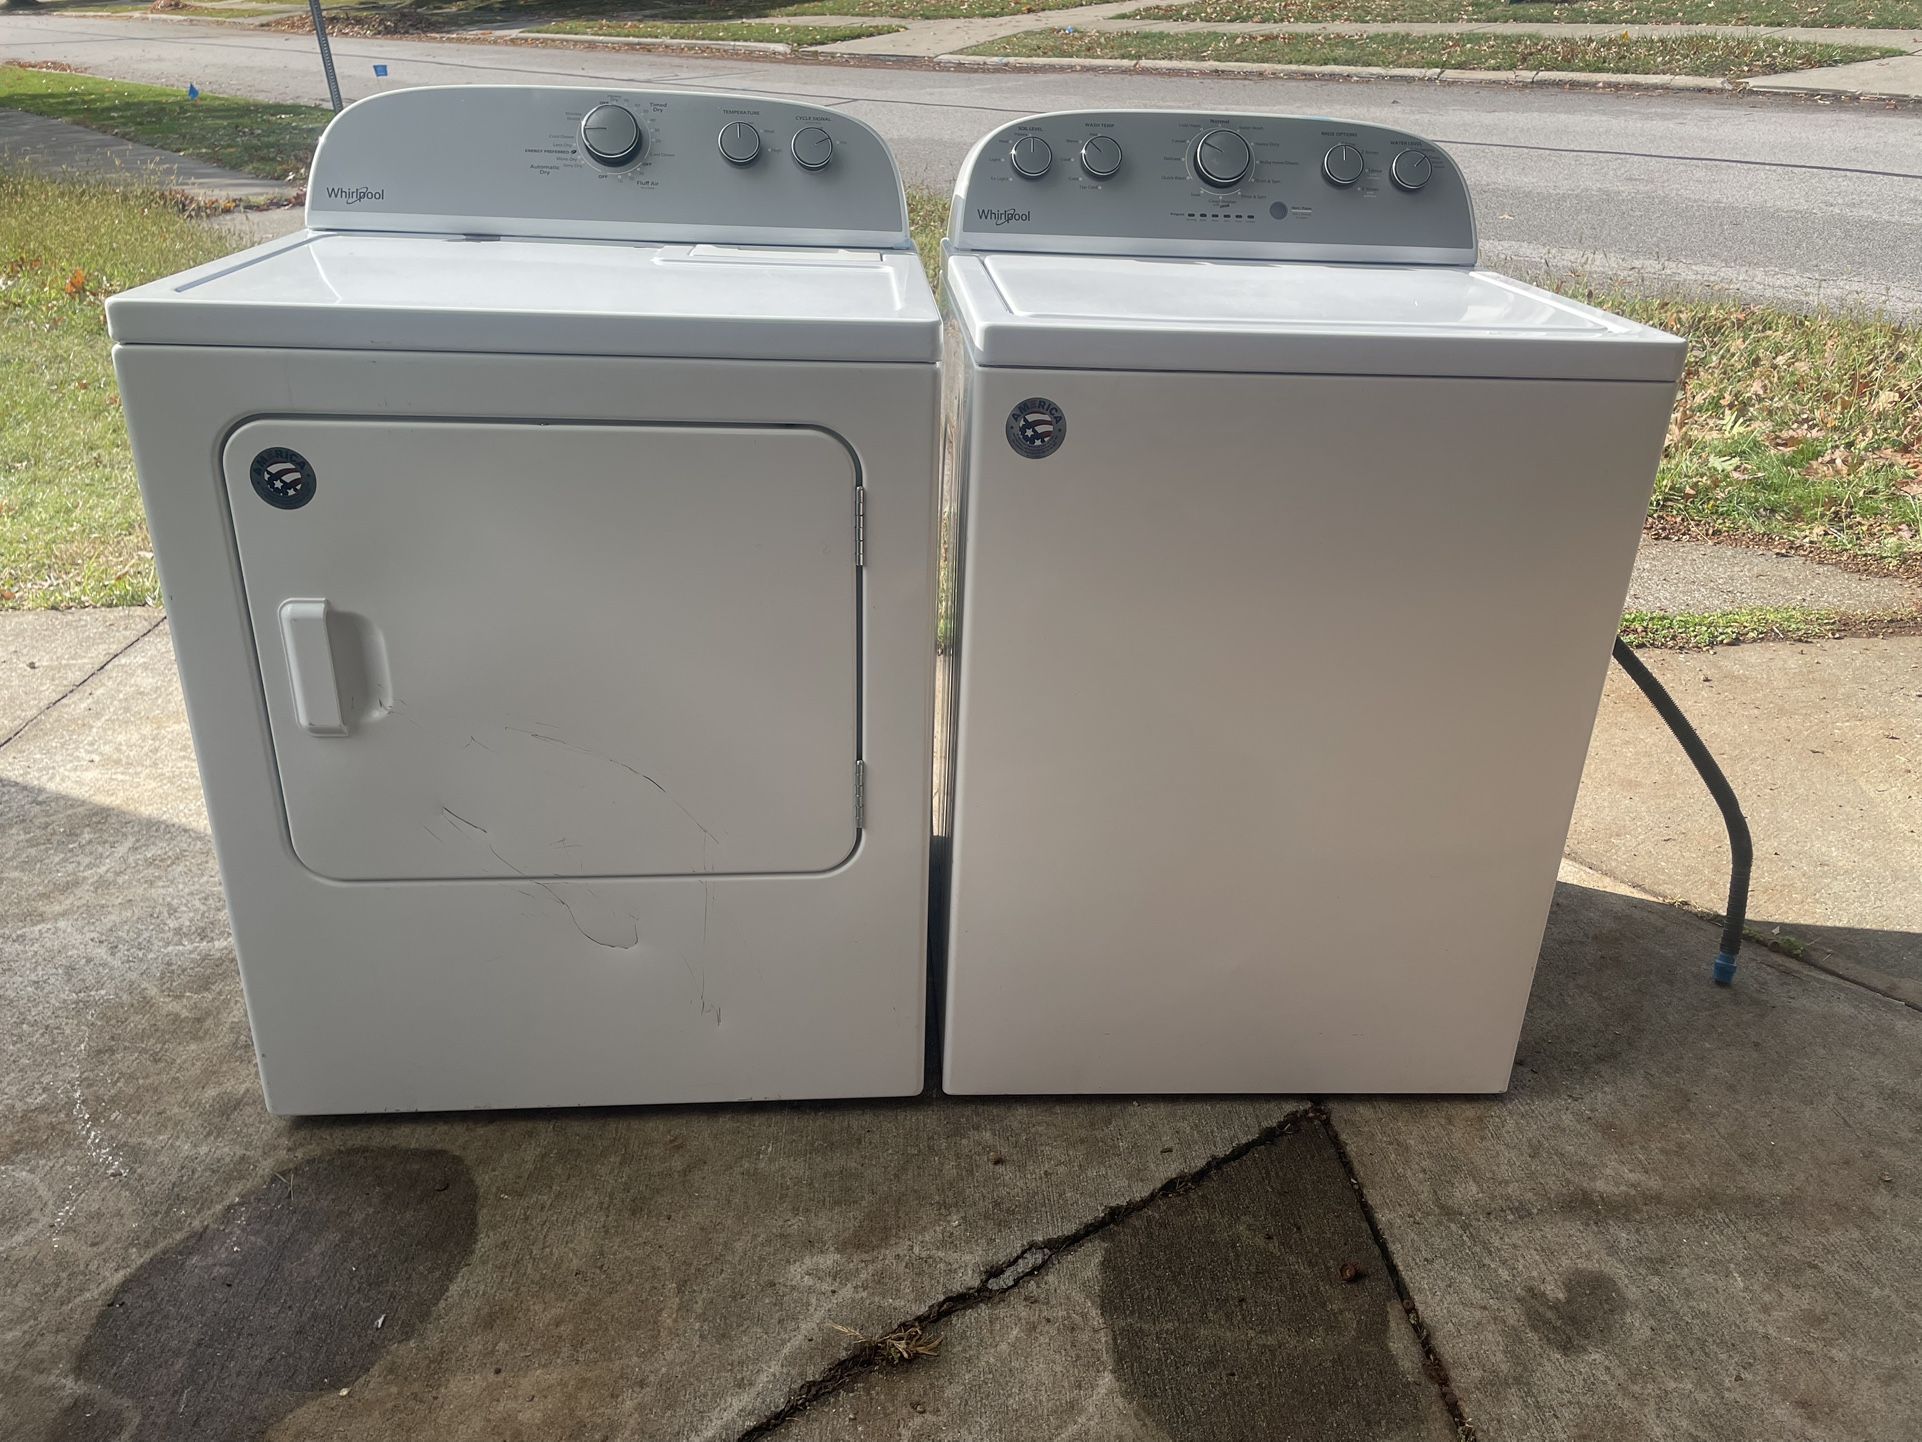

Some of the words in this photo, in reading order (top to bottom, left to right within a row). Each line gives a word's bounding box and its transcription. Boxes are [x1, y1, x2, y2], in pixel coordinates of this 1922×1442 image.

[326, 186, 385, 205] Whirlpool
[977, 208, 1031, 226] Whirlpool
[1011, 400, 1063, 425] AMERICA
